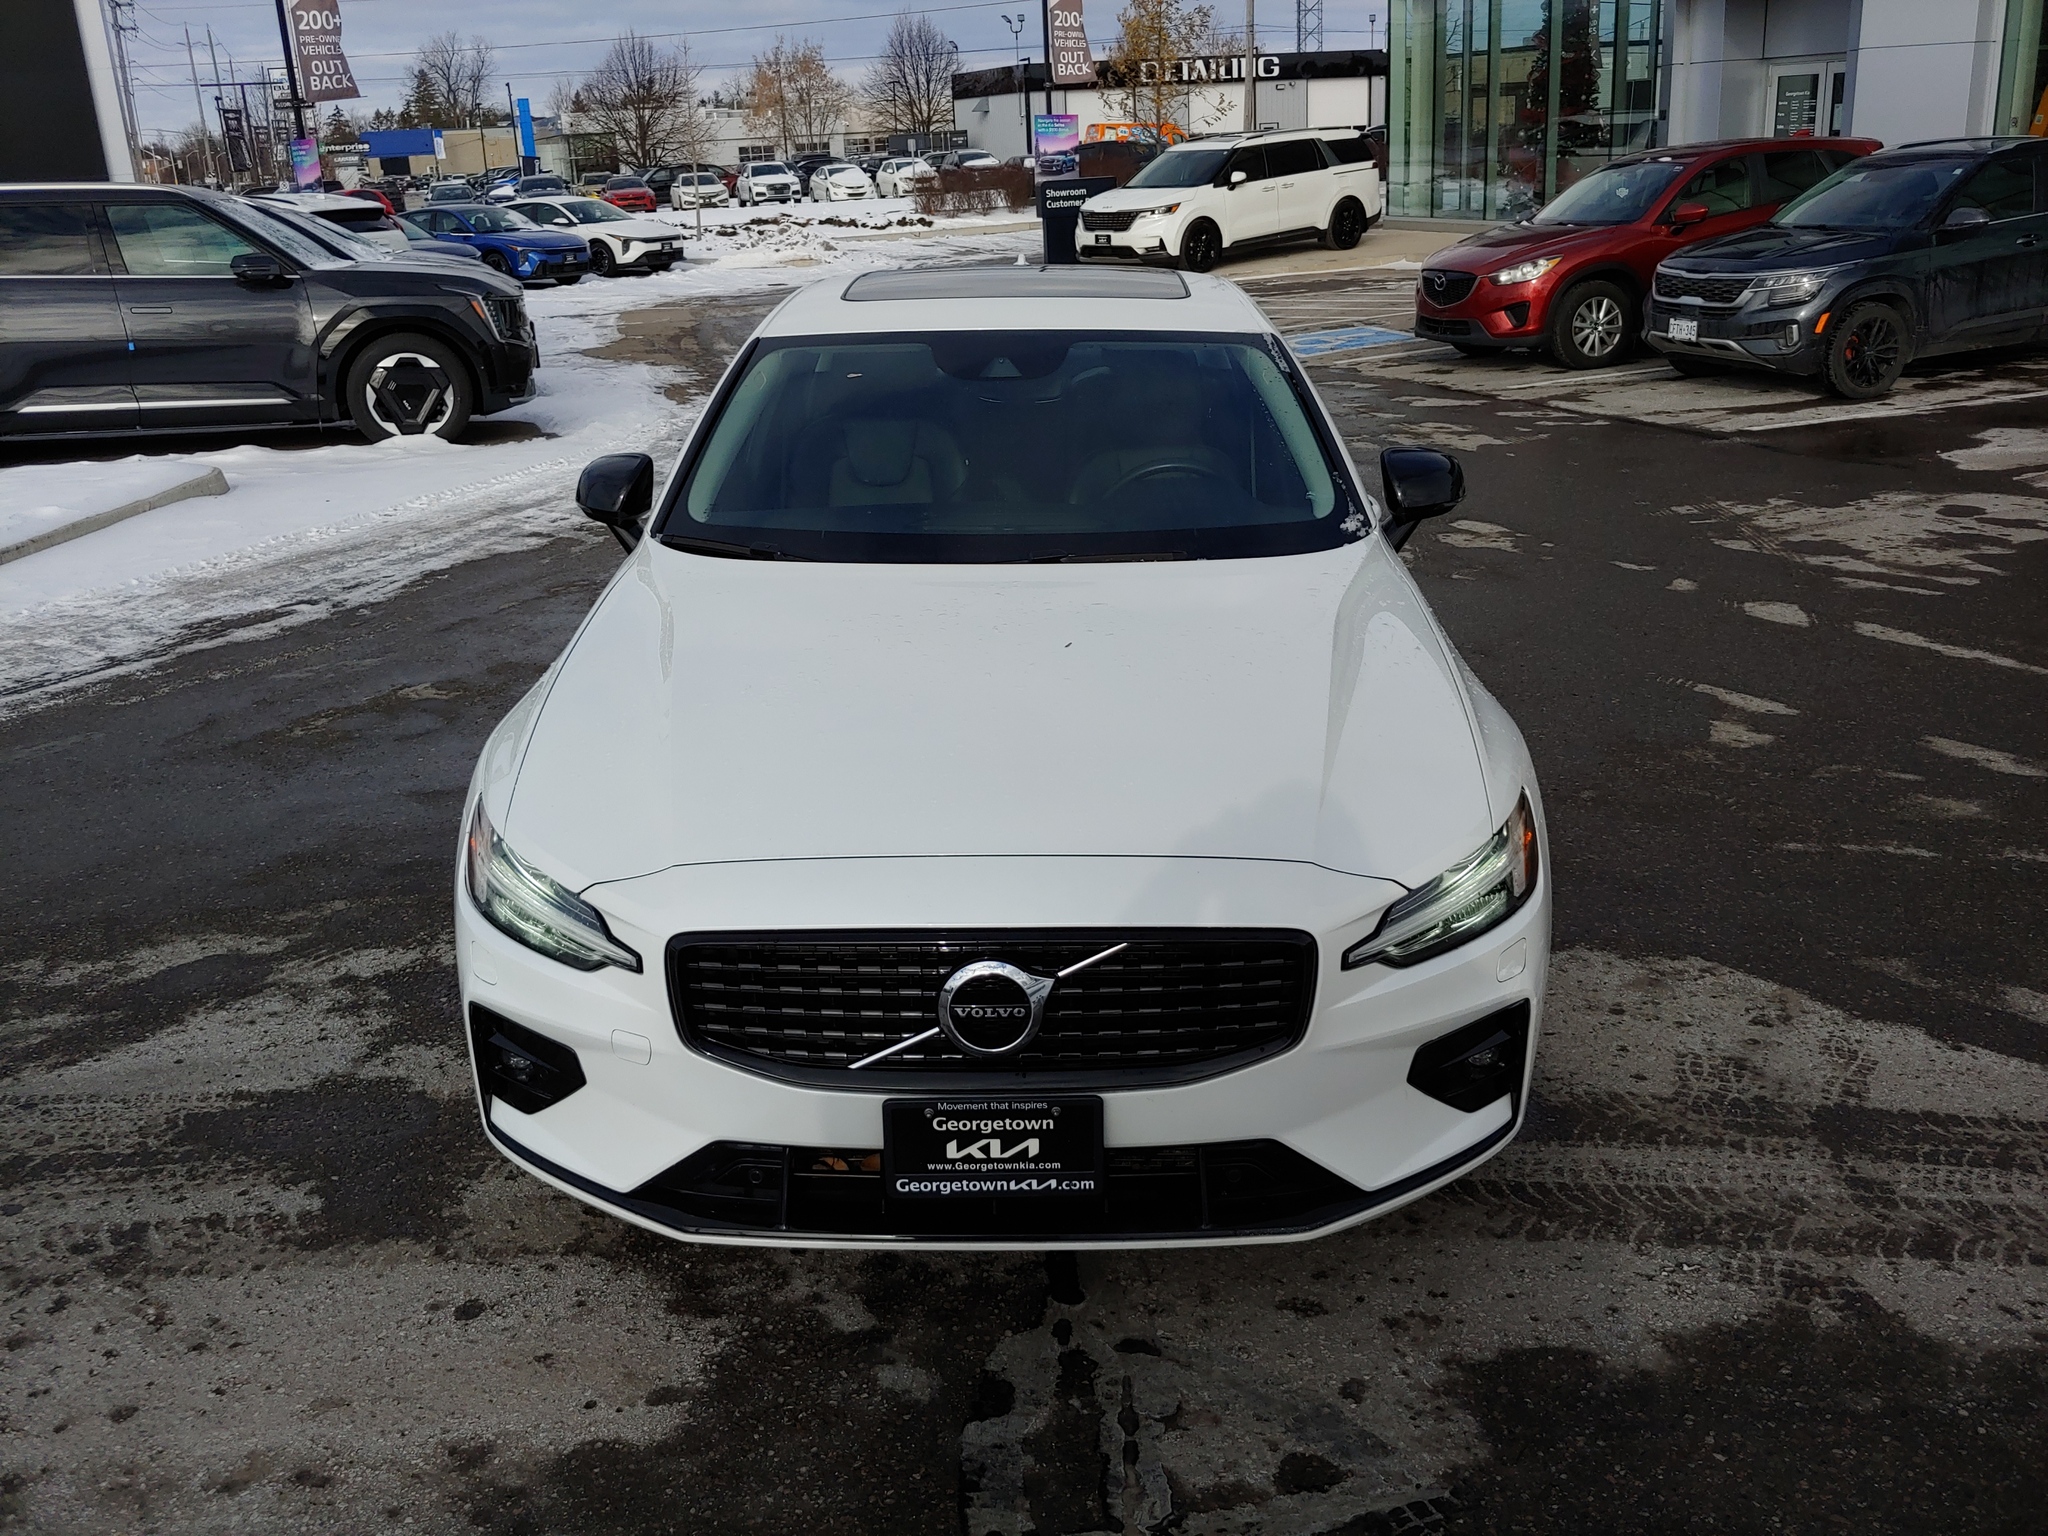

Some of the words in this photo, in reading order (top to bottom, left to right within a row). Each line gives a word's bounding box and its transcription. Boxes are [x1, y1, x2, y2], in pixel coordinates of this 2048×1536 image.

[296, 10, 342, 30] 200+
[1054, 38, 1087, 48] VEHICLES
[1060, 51, 1085, 64] OUT
[311, 60, 344, 75] OUT
[1057, 61, 1092, 76] BACK
[1141, 56, 1279, 82] DETAILIG
[310, 73, 353, 91] BACK
[319, 143, 370, 154] enterprise
[1045, 188, 1087, 198] Showroom
[1046, 199, 1084, 209] Customer
[954, 1007, 1026, 1018] VOLVO
[937, 1102, 988, 1111] Movement
[990, 1101, 1009, 1110] that
[1012, 1101, 1048, 1112] inspires
[932, 1117, 1054, 1134] Georgetown
[927, 1161, 1061, 1172] www.Georgetownkia.com
